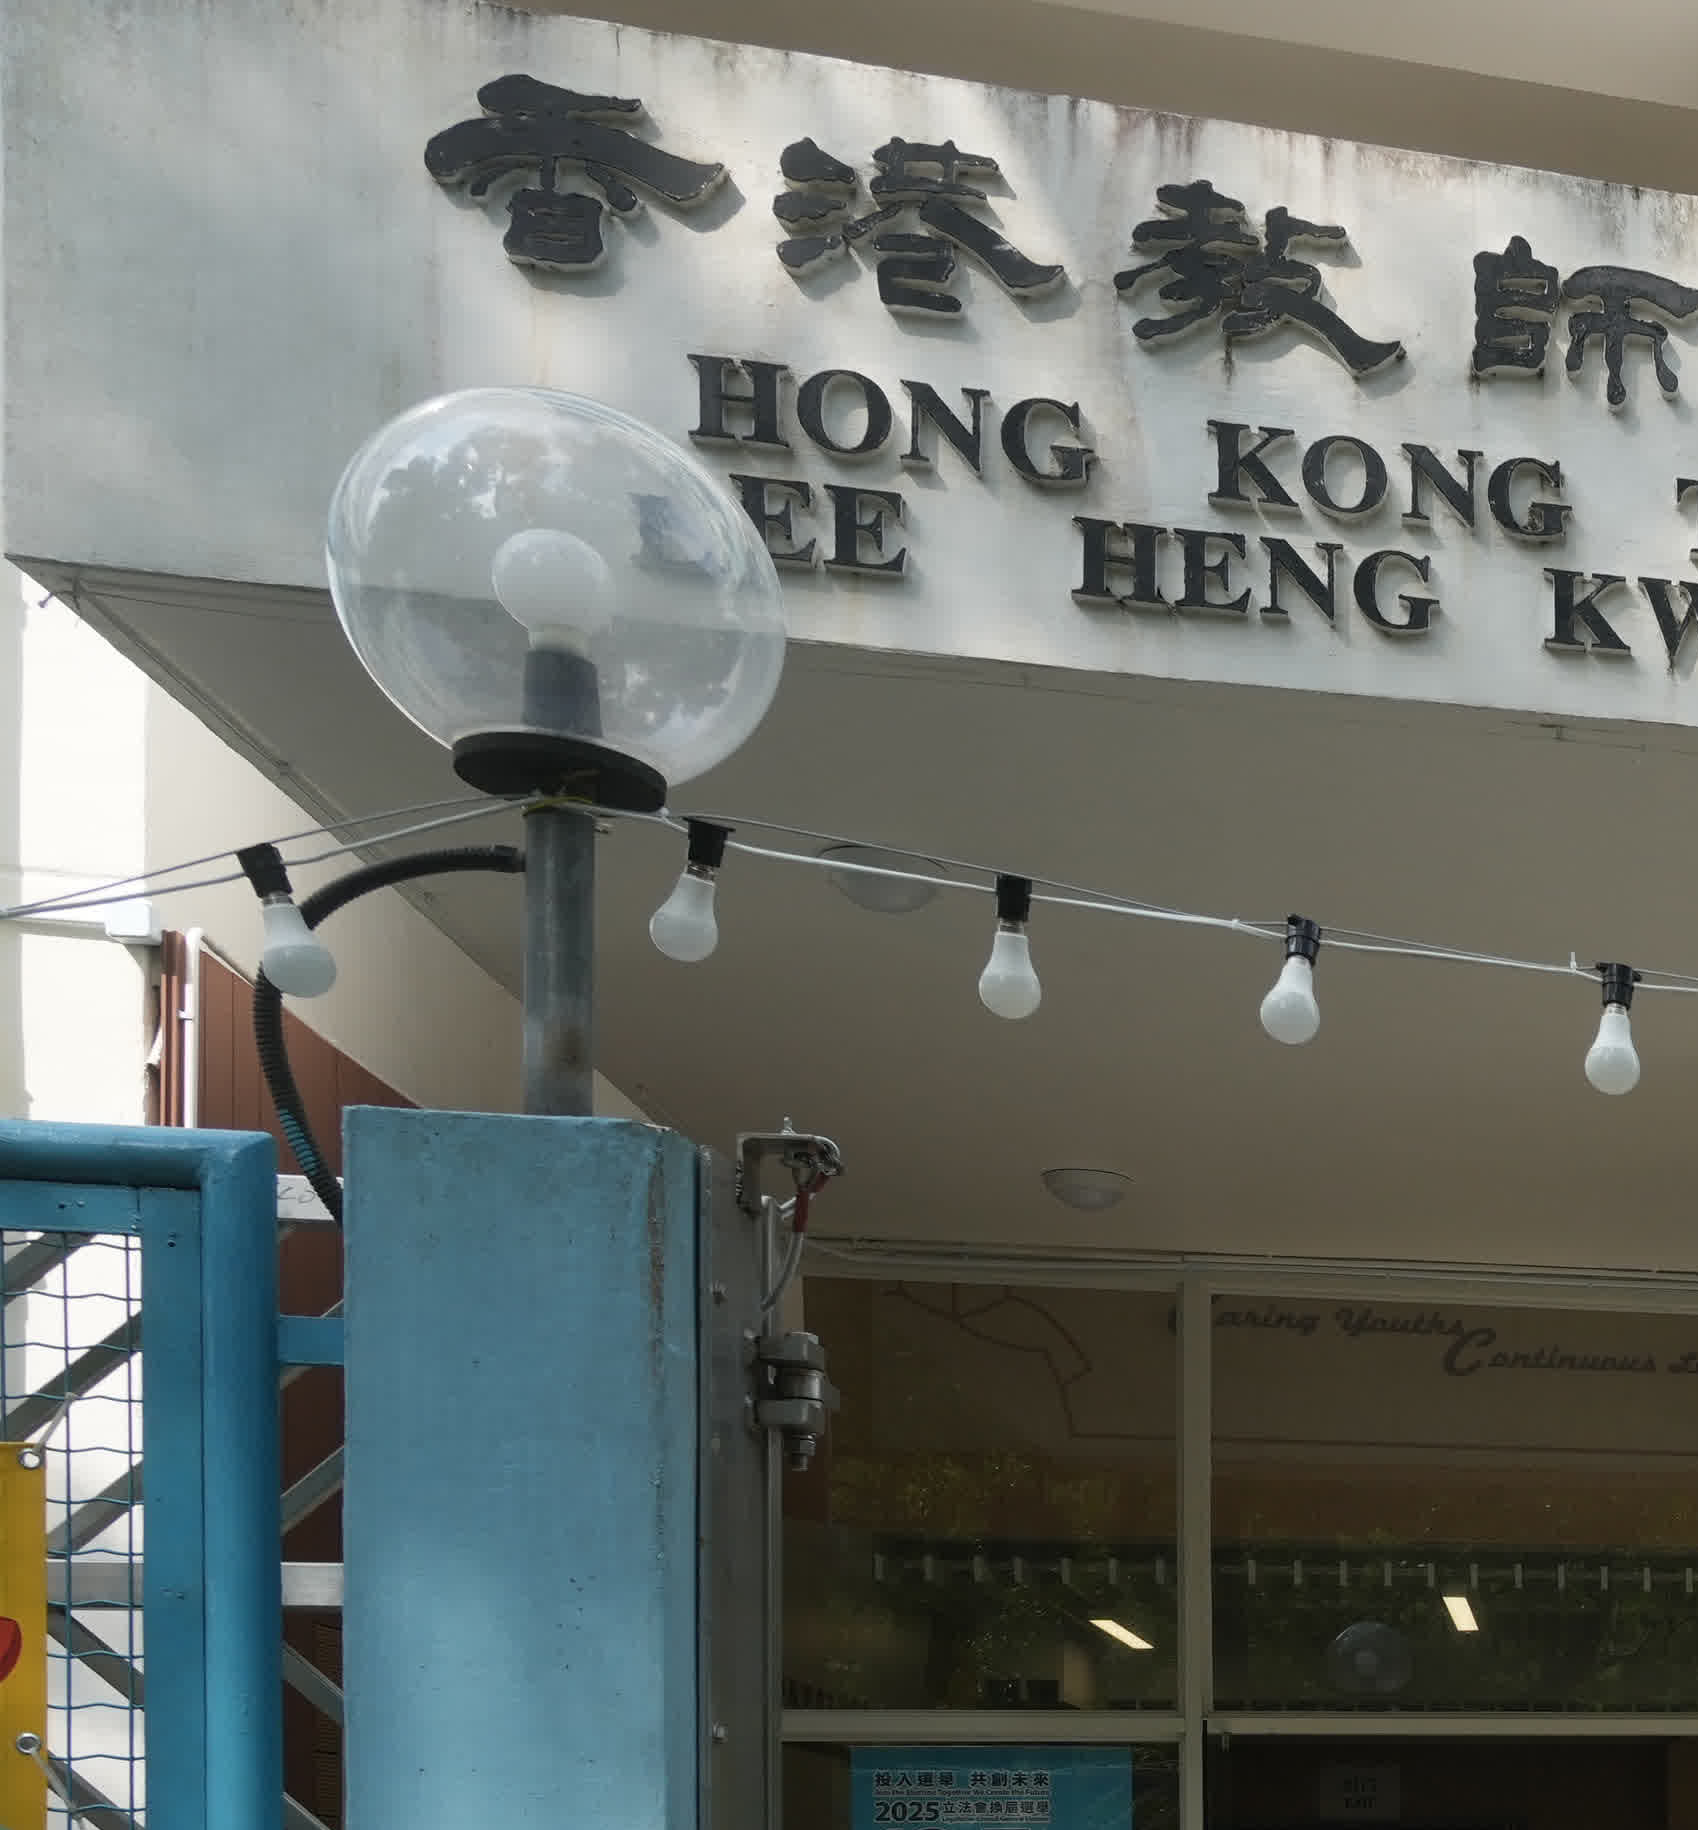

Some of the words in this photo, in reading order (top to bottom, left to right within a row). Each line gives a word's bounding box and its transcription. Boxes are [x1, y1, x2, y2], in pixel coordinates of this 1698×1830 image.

[686, 353, 1098, 484] HONG
[1207, 419, 1573, 541] KONG
[1072, 515, 1440, 635] HENG
[1167, 1292, 1321, 1336] aring
[1443, 1326, 1657, 1377] Continuous
